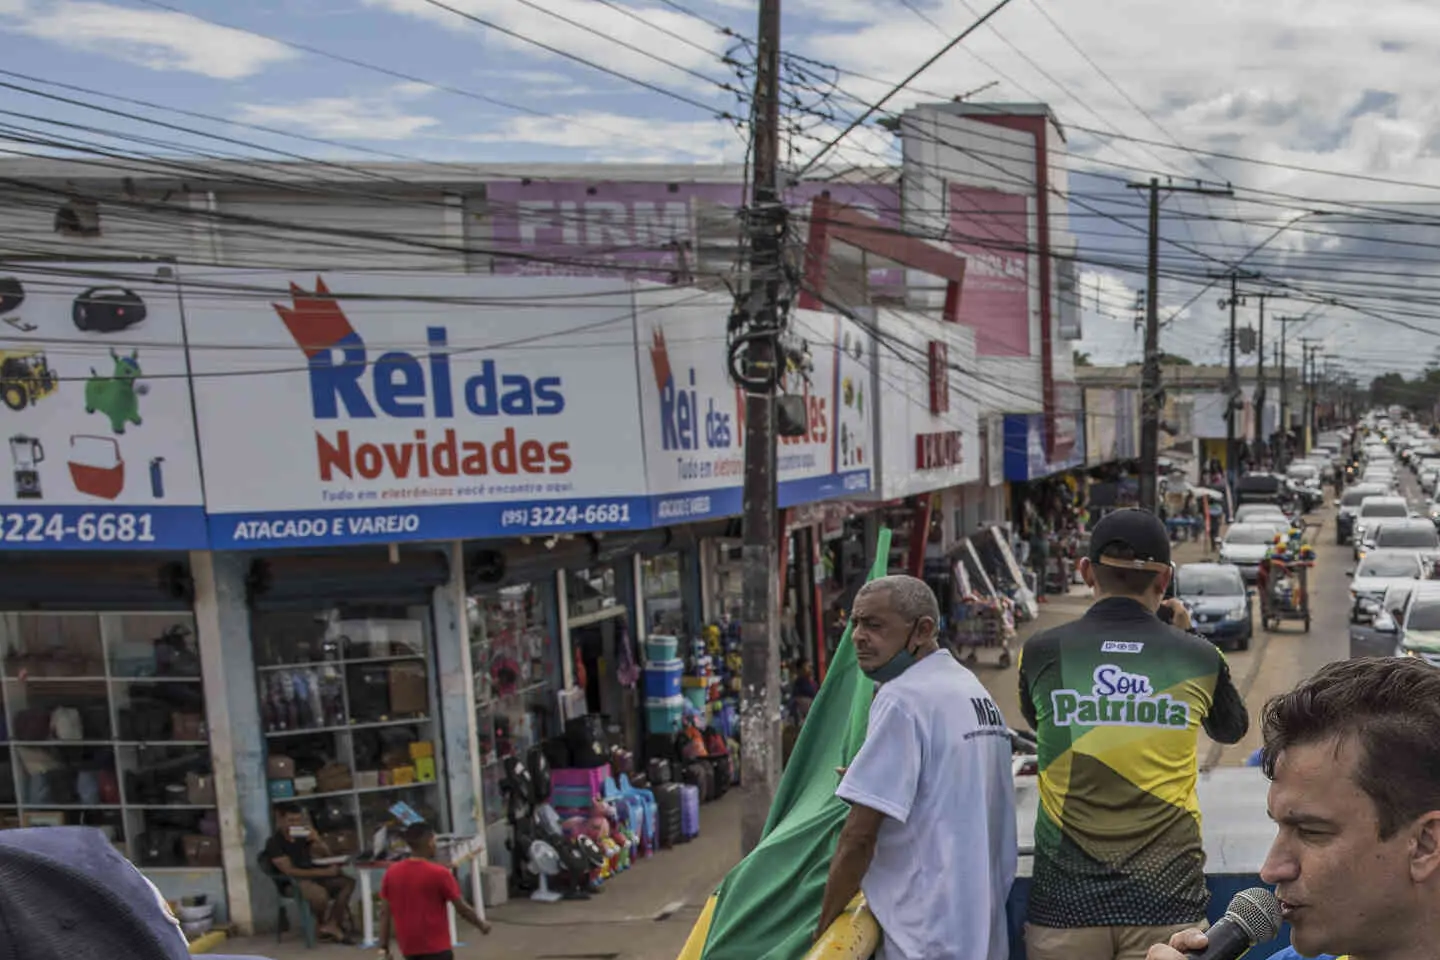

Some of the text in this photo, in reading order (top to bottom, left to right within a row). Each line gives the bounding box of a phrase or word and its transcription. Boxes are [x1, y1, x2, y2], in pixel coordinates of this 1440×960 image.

[308, 326, 565, 419] Rei das
[660, 368, 698, 451] Rei
[706, 399, 731, 448] das
[315, 427, 572, 482] Novidades
[233, 514, 419, 540] ATACADO E VAREJO
[501, 504, 630, 527] (95) 3224-6681
[1096, 669, 1148, 696] Sou
[1055, 694, 1187, 726] Patriota
